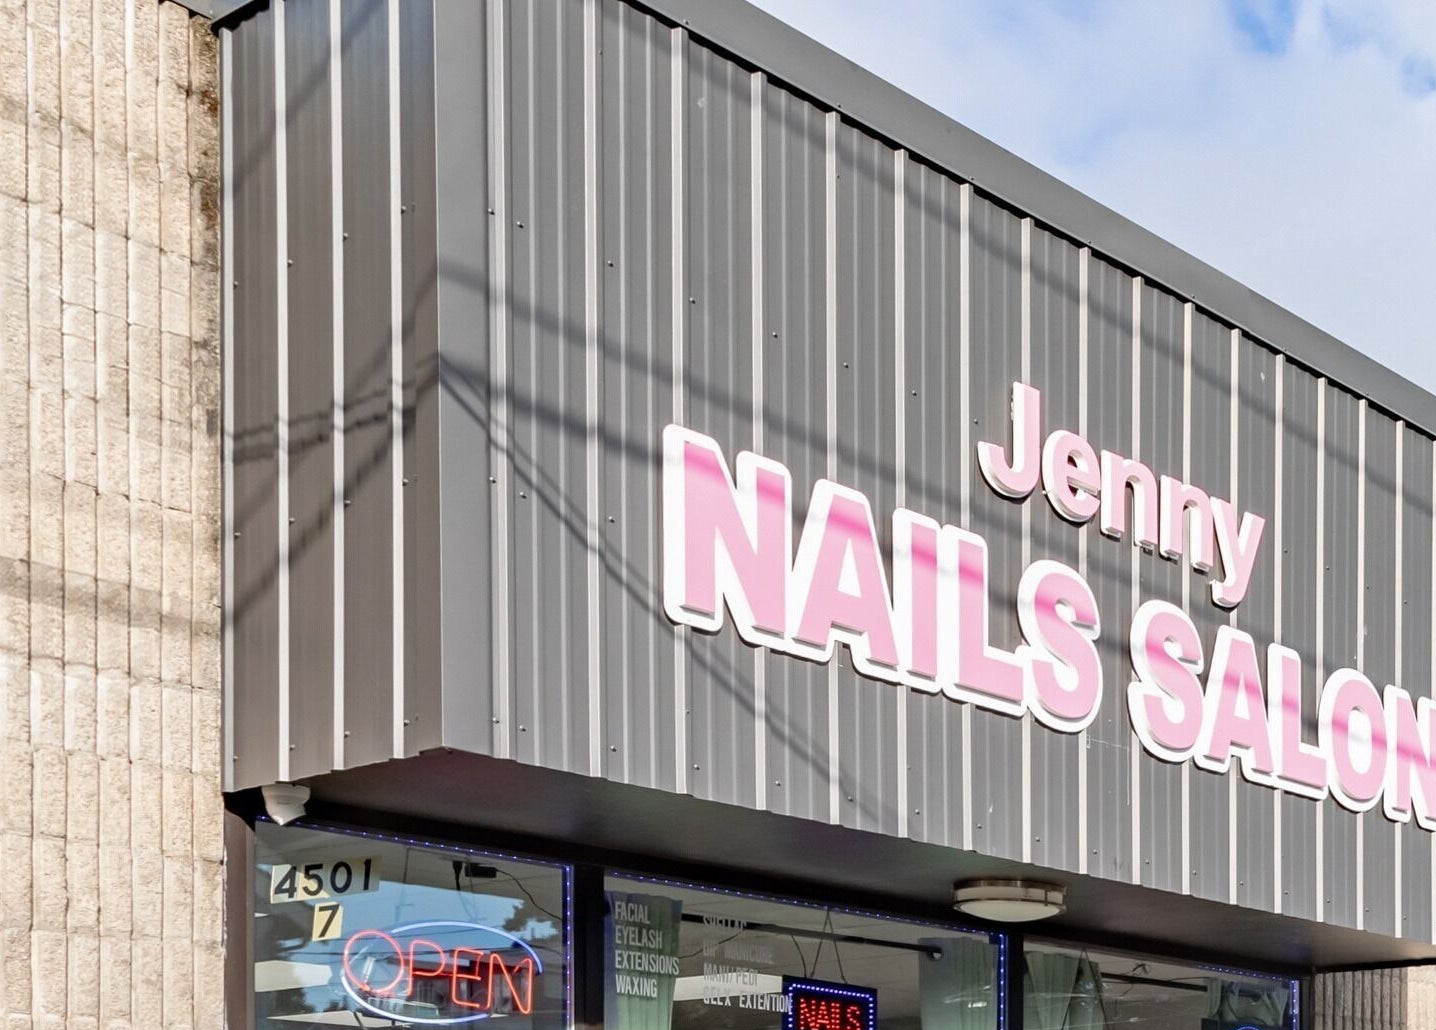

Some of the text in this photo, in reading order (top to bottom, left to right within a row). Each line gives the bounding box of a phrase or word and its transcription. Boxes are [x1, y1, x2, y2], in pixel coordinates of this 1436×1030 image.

[977, 381, 1265, 608] Jenny
[662, 423, 1103, 733] NAILS
[274, 858, 373, 899] 4501
[317, 903, 341, 939] 7
[615, 901, 651, 925] FACIAL
[615, 925, 663, 949] EYELASH
[343, 929, 533, 1015] OPEN
[615, 950, 680, 976] EXTENSIONS
[615, 974, 658, 999] WAXING
